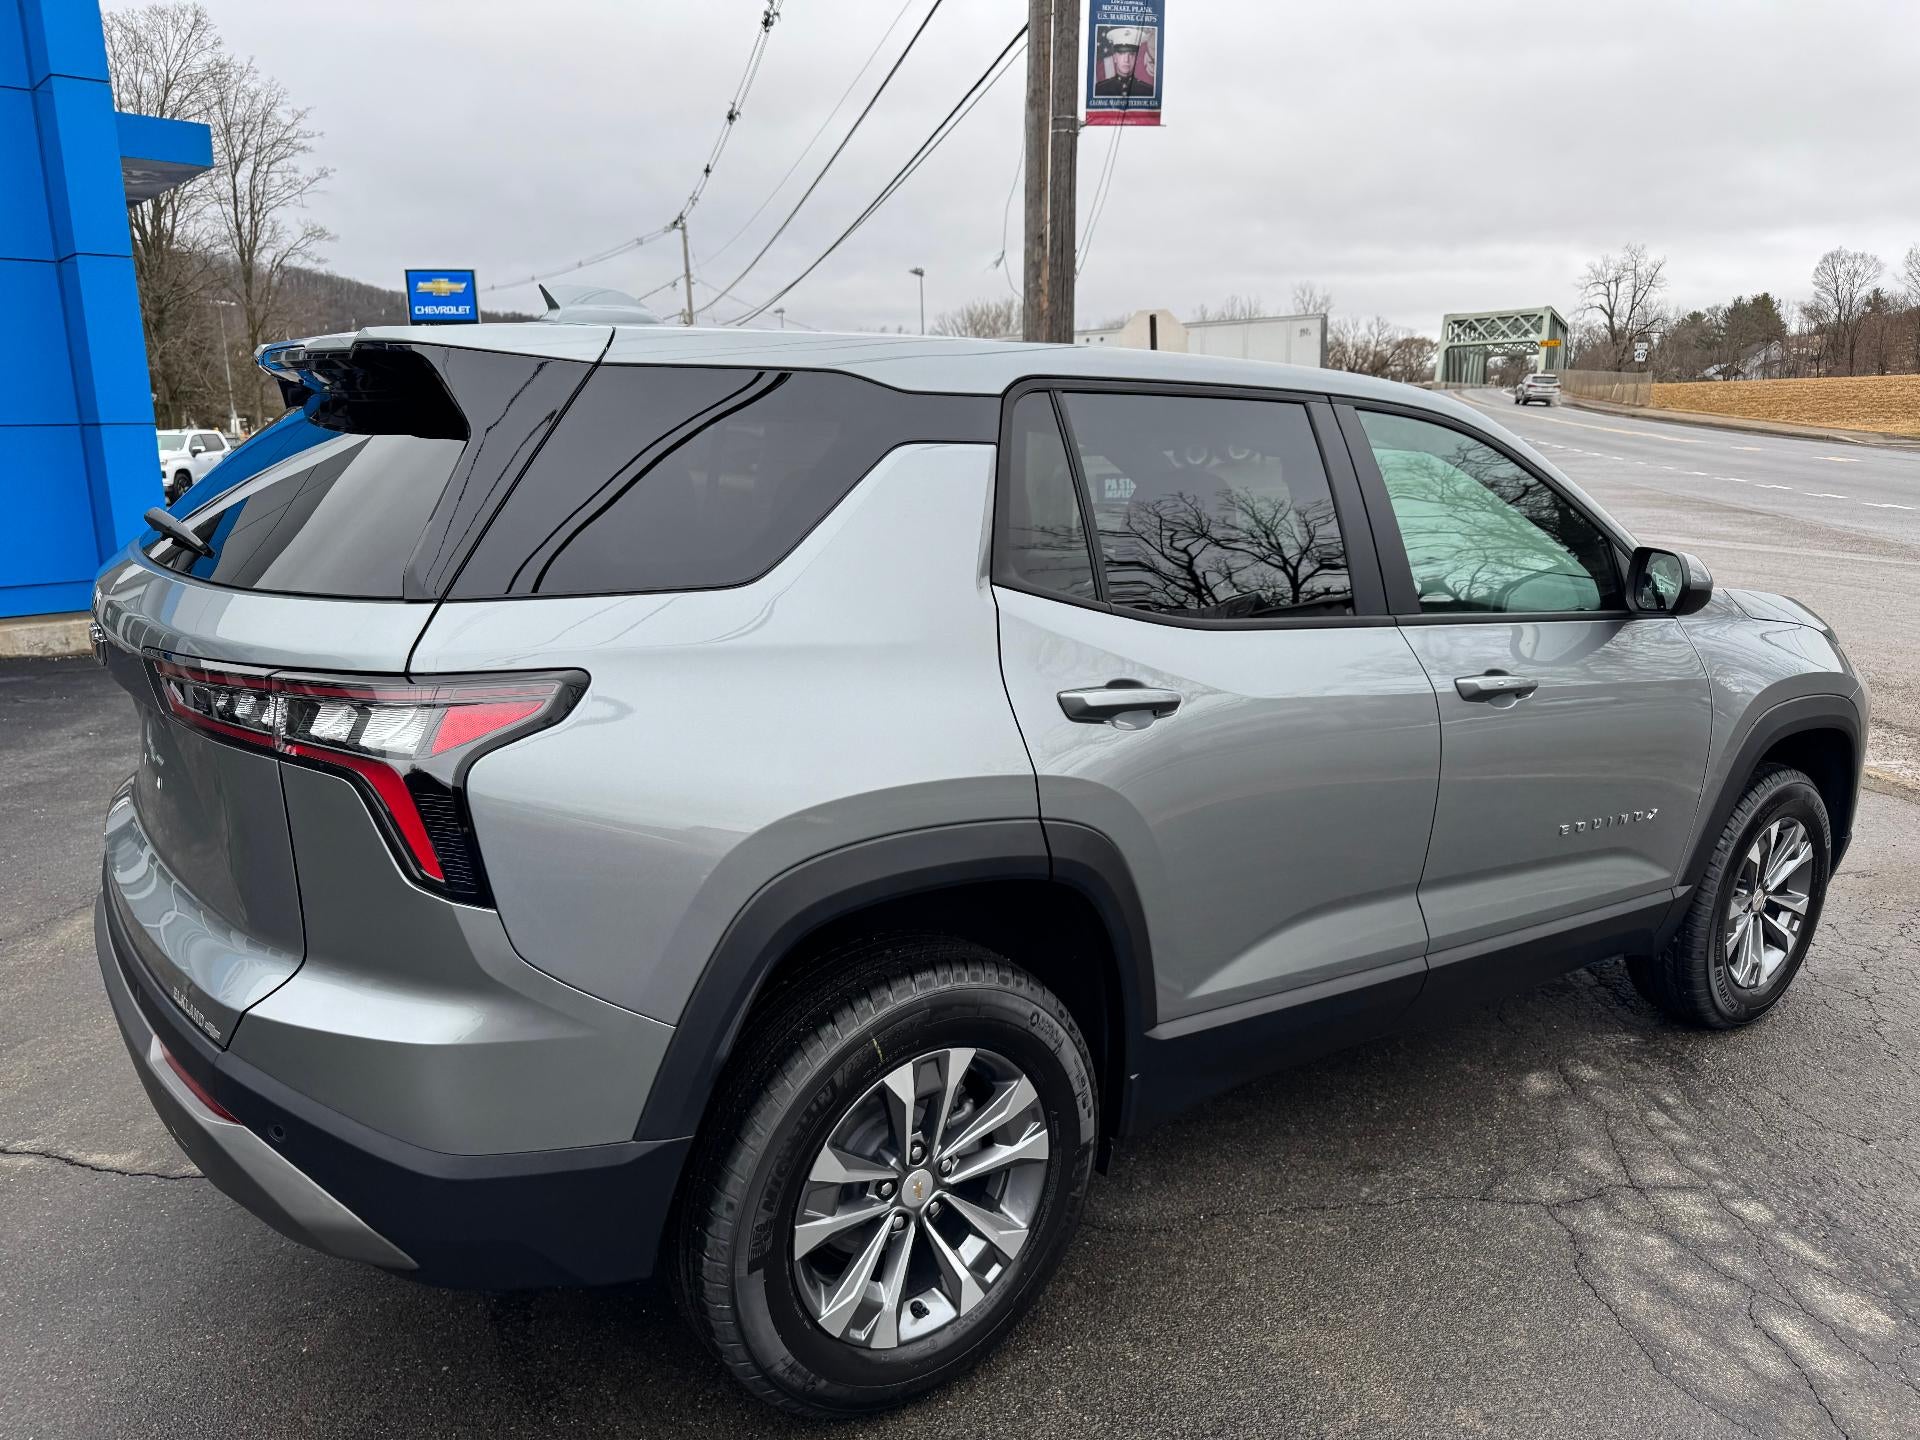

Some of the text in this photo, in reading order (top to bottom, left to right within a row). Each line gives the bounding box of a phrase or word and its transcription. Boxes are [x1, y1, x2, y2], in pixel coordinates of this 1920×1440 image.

[1102, 4, 1131, 12] MICHAEL
[1110, 13, 1135, 21] MARINE
[415, 306, 471, 315] CHEVROLET
[1635, 351, 1646, 360] 49
[1559, 808, 1658, 835] EQUINOX
[1714, 967, 1738, 1011] MICHELIN
